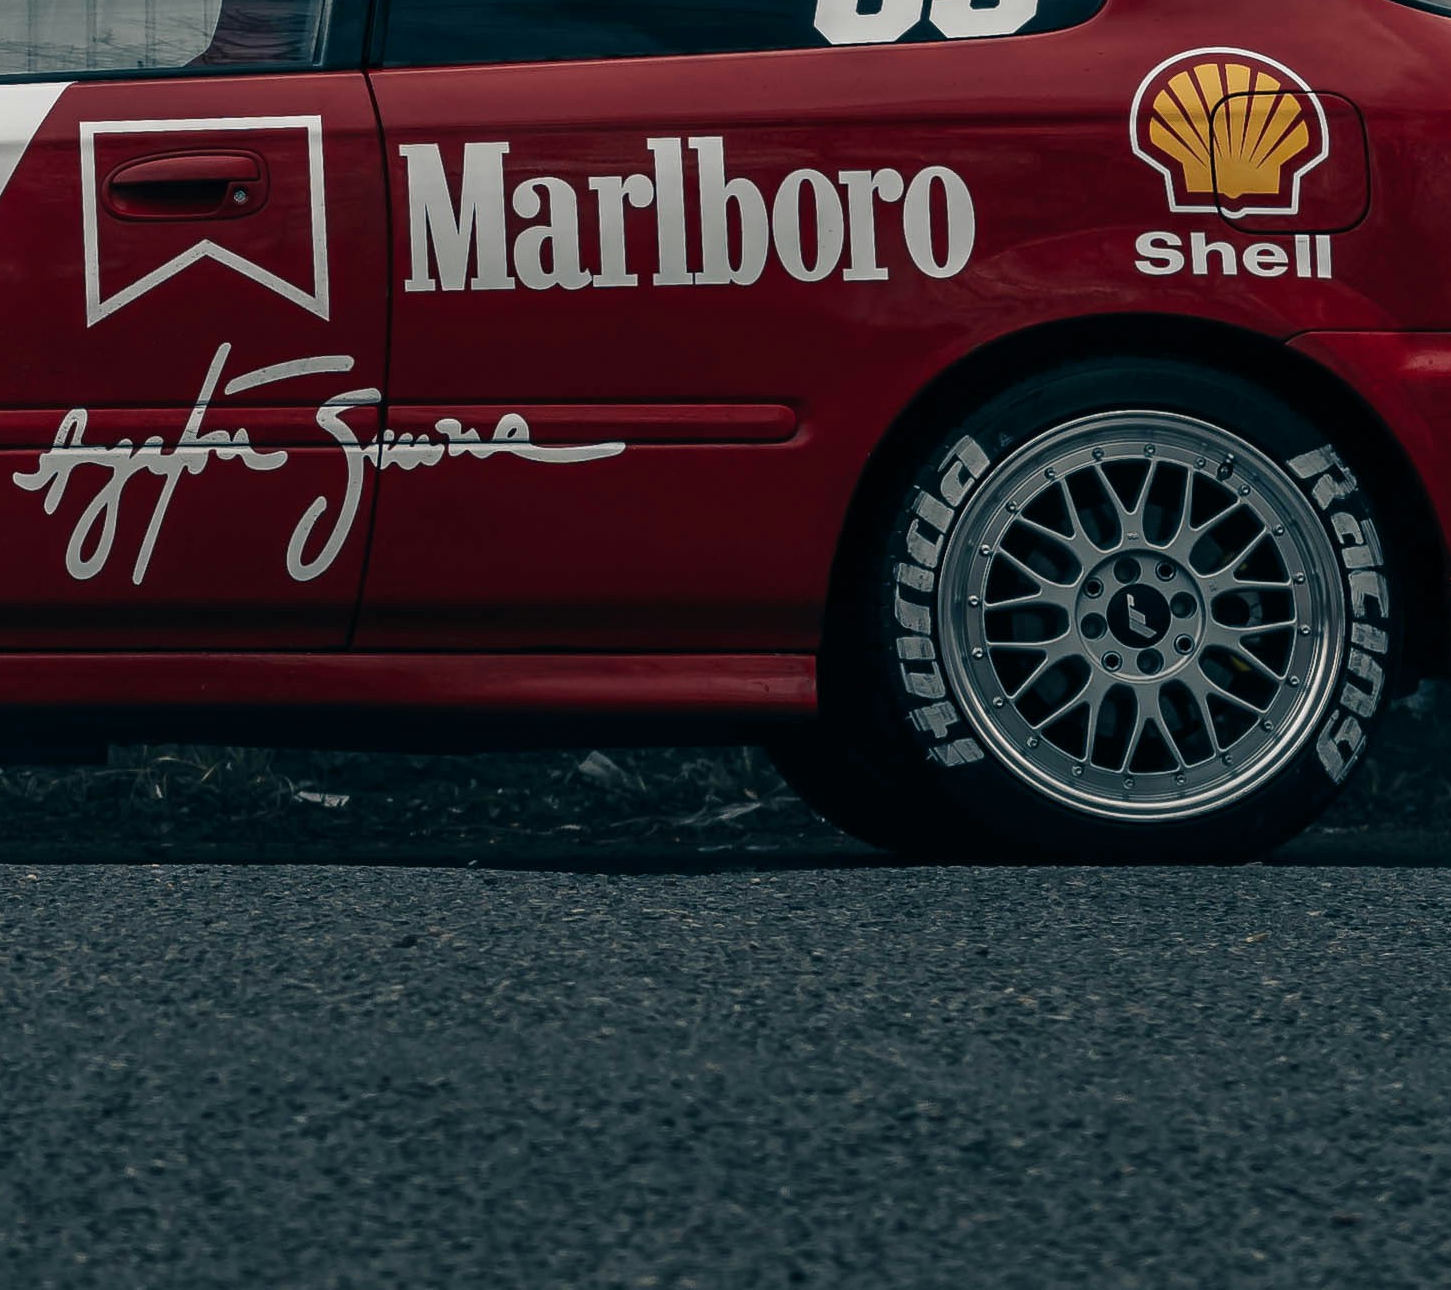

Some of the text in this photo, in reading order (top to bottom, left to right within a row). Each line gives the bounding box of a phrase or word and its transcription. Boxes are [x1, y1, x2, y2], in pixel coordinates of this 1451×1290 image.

[398, 135, 977, 293] Marlboro
[1133, 230, 1333, 281] Shell
[893, 433, 992, 767] Honda
[1285, 443, 1390, 785] Racing
